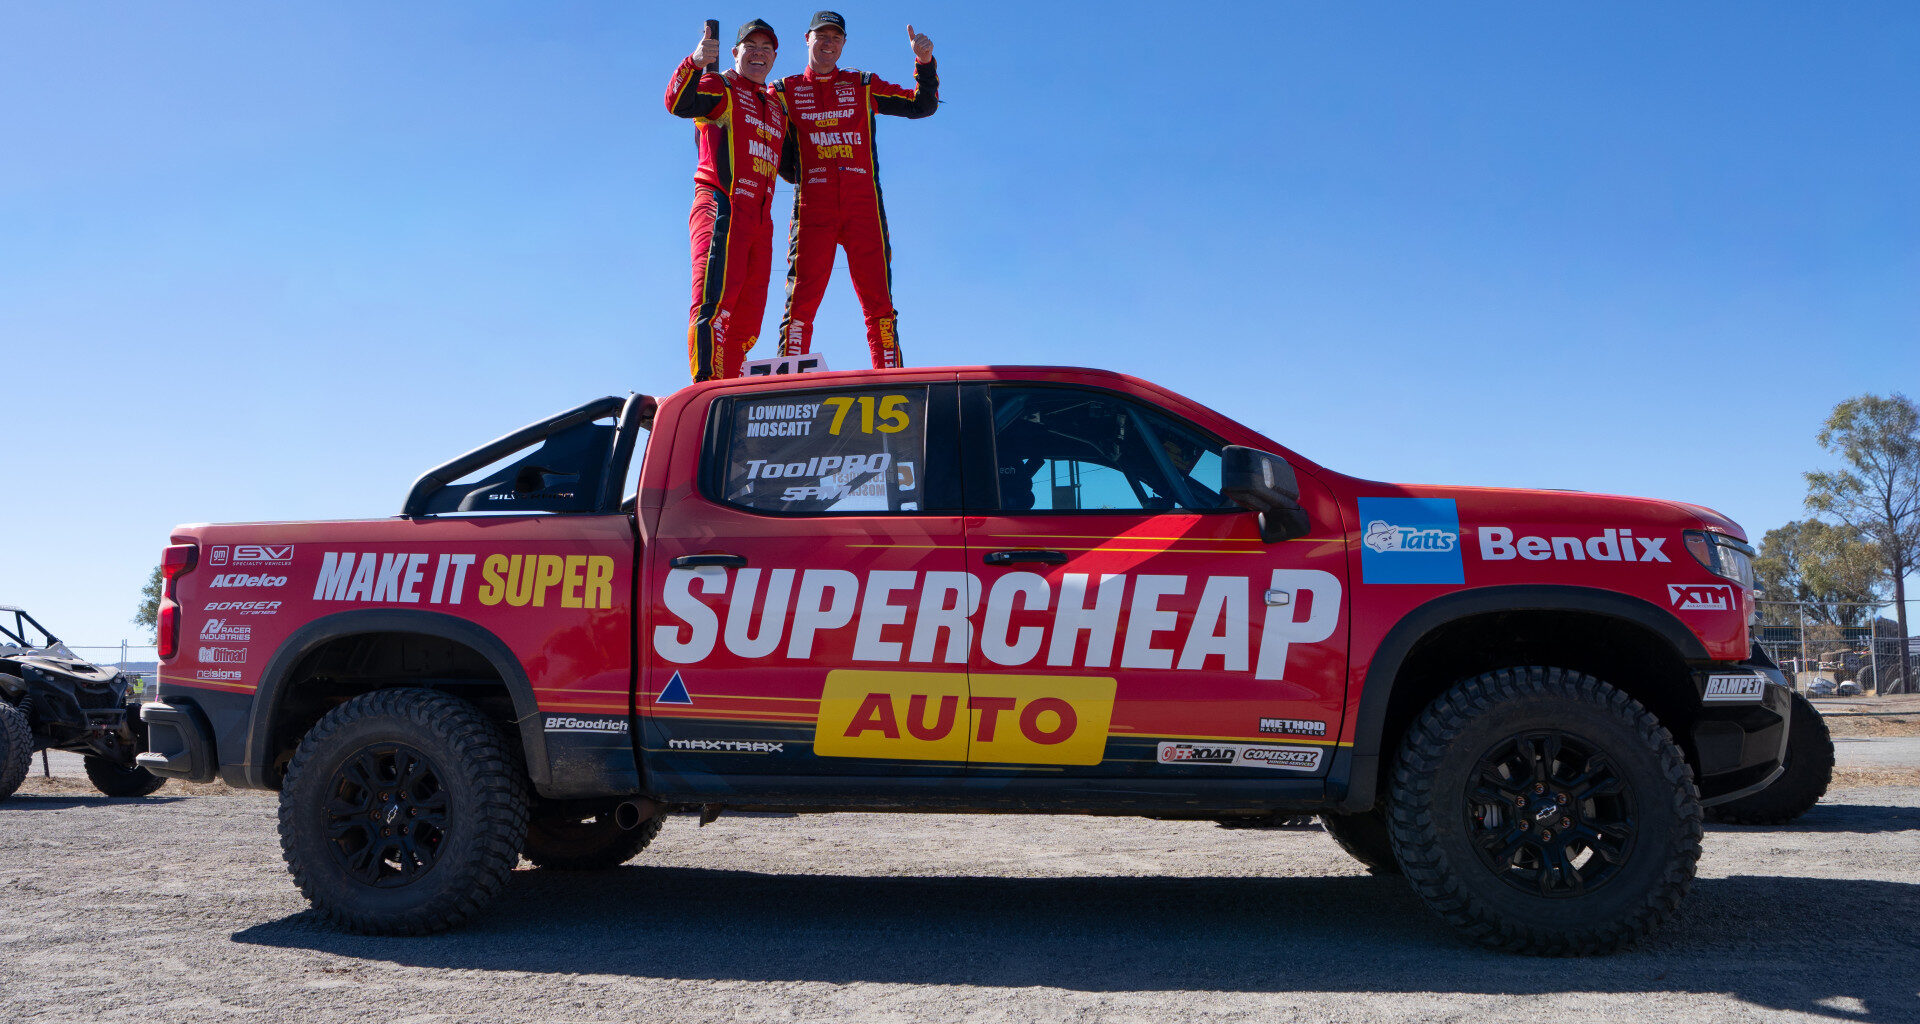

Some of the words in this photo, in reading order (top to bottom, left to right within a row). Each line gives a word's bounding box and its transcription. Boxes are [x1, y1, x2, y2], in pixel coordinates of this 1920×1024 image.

[801, 109, 854, 120] SUPERCHEAP
[809, 131, 841, 146] MAKE
[817, 145, 853, 159] SUPER
[880, 318, 894, 348] SUPER
[748, 403, 820, 421] LOWNDESY
[823, 395, 910, 436] 715
[747, 421, 811, 437] MOSCATT
[746, 453, 891, 480] ToolPRO
[1398, 528, 1454, 551] Tatts
[1478, 526, 1671, 563] Bendix
[209, 573, 287, 588] ACDelco
[313, 552, 429, 603] MAKE
[430, 553, 476, 605] IT
[478, 554, 615, 609] SUPER
[1671, 586, 1730, 609] XTM
[204, 601, 282, 611] BORGER
[653, 566, 1342, 681] SUPERCHEAP
[200, 633, 250, 641] INDUSTRIES
[197, 668, 242, 679] nelsigns
[1710, 674, 1762, 696] RAMPEX
[545, 717, 629, 731] BFGoodrich
[843, 692, 1078, 745] AUTO
[1261, 719, 1325, 731] METHOD
[669, 739, 783, 753] MAXTRAX
[1244, 749, 1318, 762] COMISKEY
